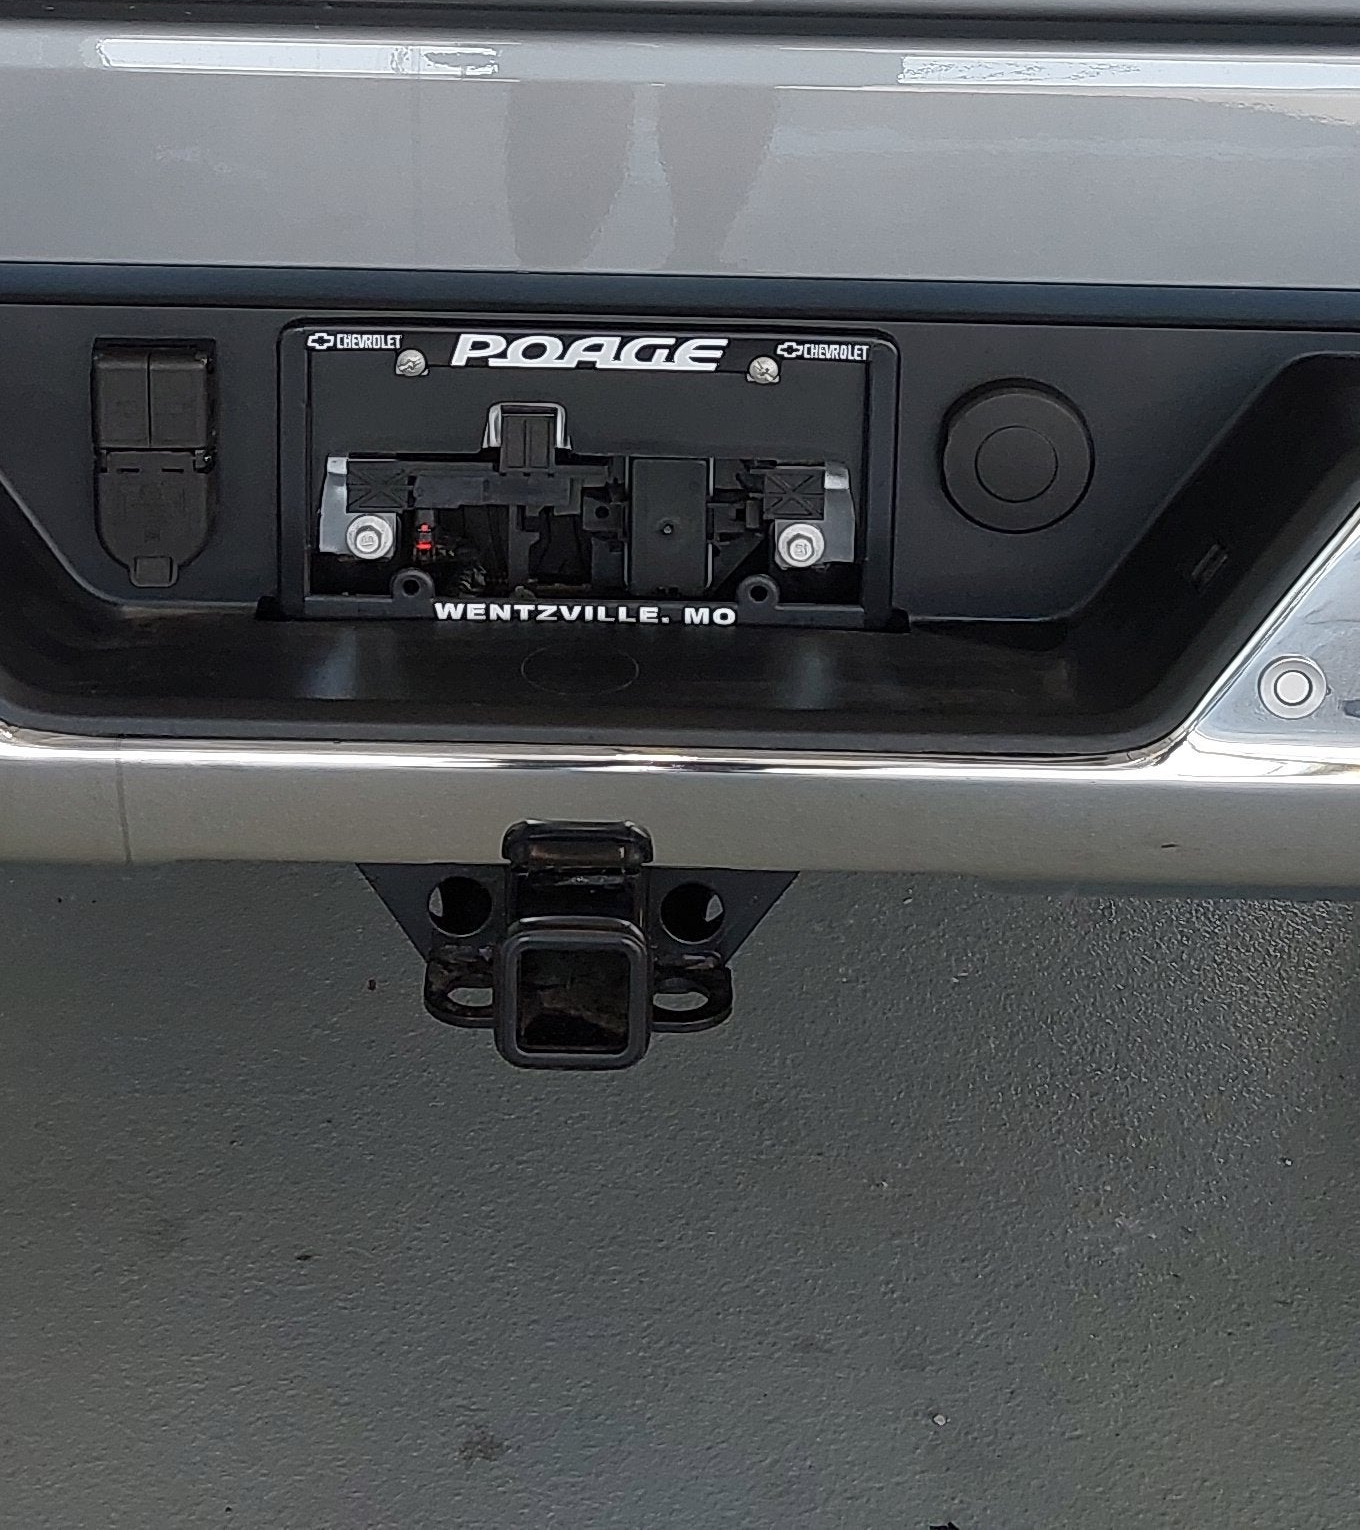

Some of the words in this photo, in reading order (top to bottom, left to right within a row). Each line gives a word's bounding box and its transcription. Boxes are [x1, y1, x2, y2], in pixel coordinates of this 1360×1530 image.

[336, 333, 403, 349] CHEVROLET
[450, 333, 729, 371] POAGE
[802, 343, 870, 361] CHEVROLET
[684, 606, 737, 626] MO
